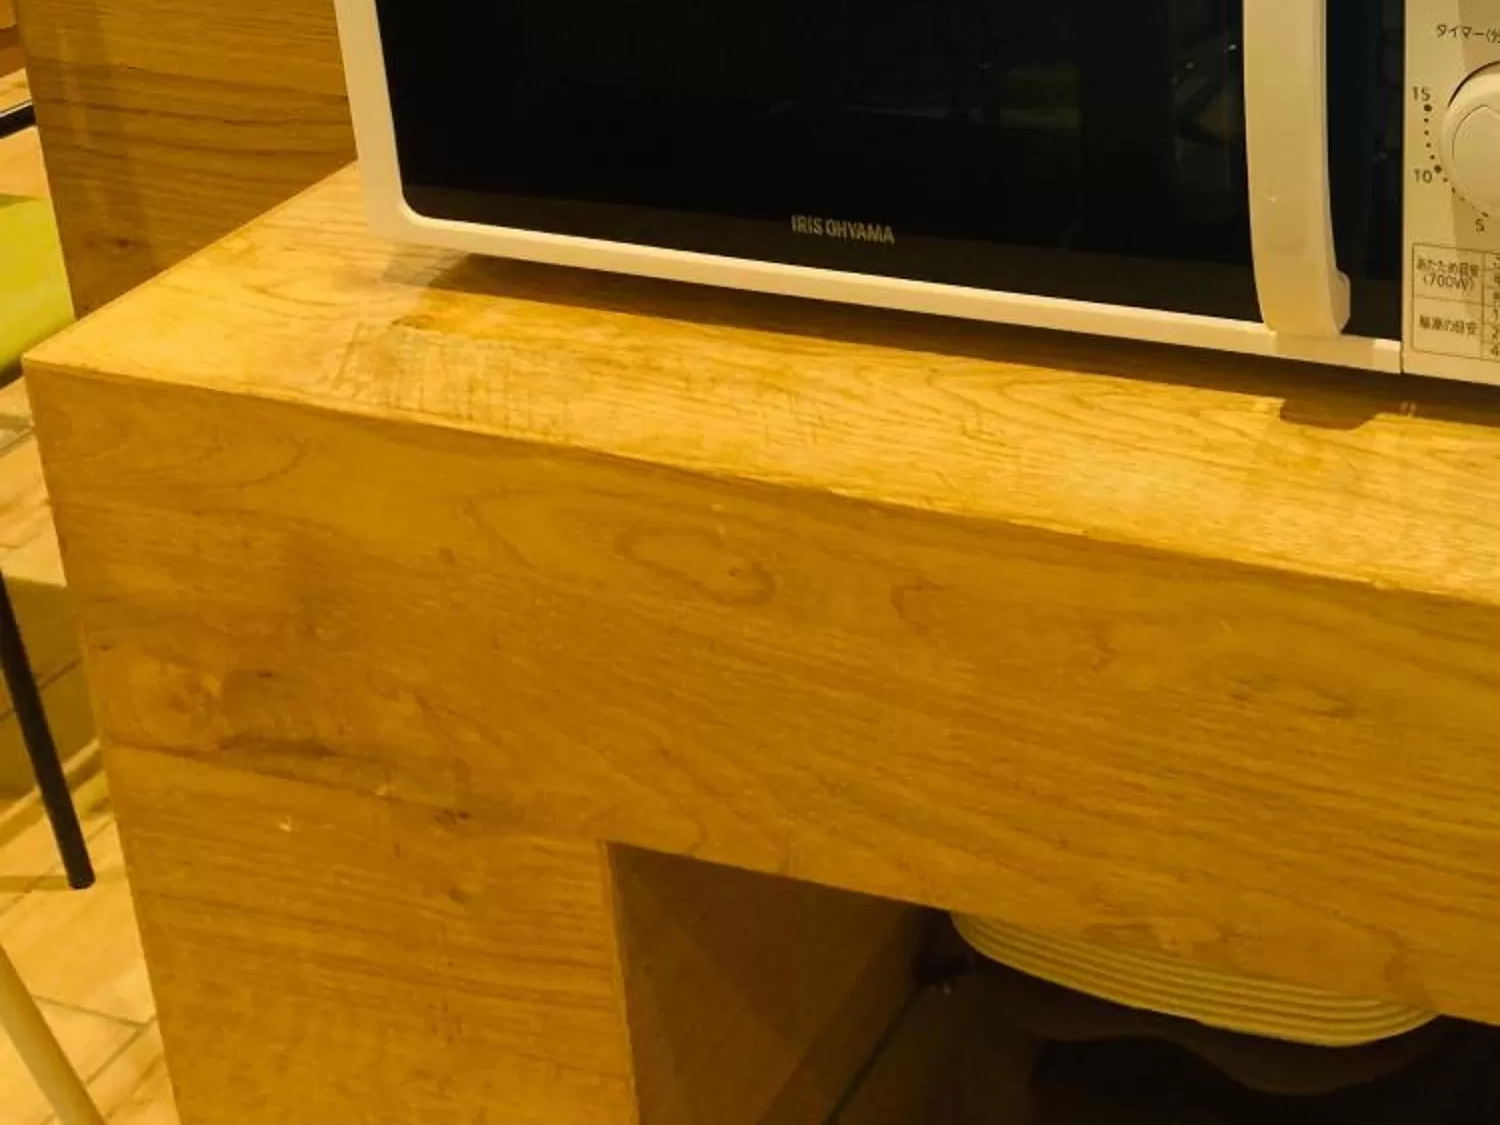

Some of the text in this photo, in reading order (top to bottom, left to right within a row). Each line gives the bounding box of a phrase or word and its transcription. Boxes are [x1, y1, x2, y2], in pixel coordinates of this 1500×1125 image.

[1412, 86, 1431, 102] 15
[1413, 169, 1433, 185] 10
[791, 214, 896, 245] IRIS OHYAMA
[1475, 218, 1486, 233] 5
